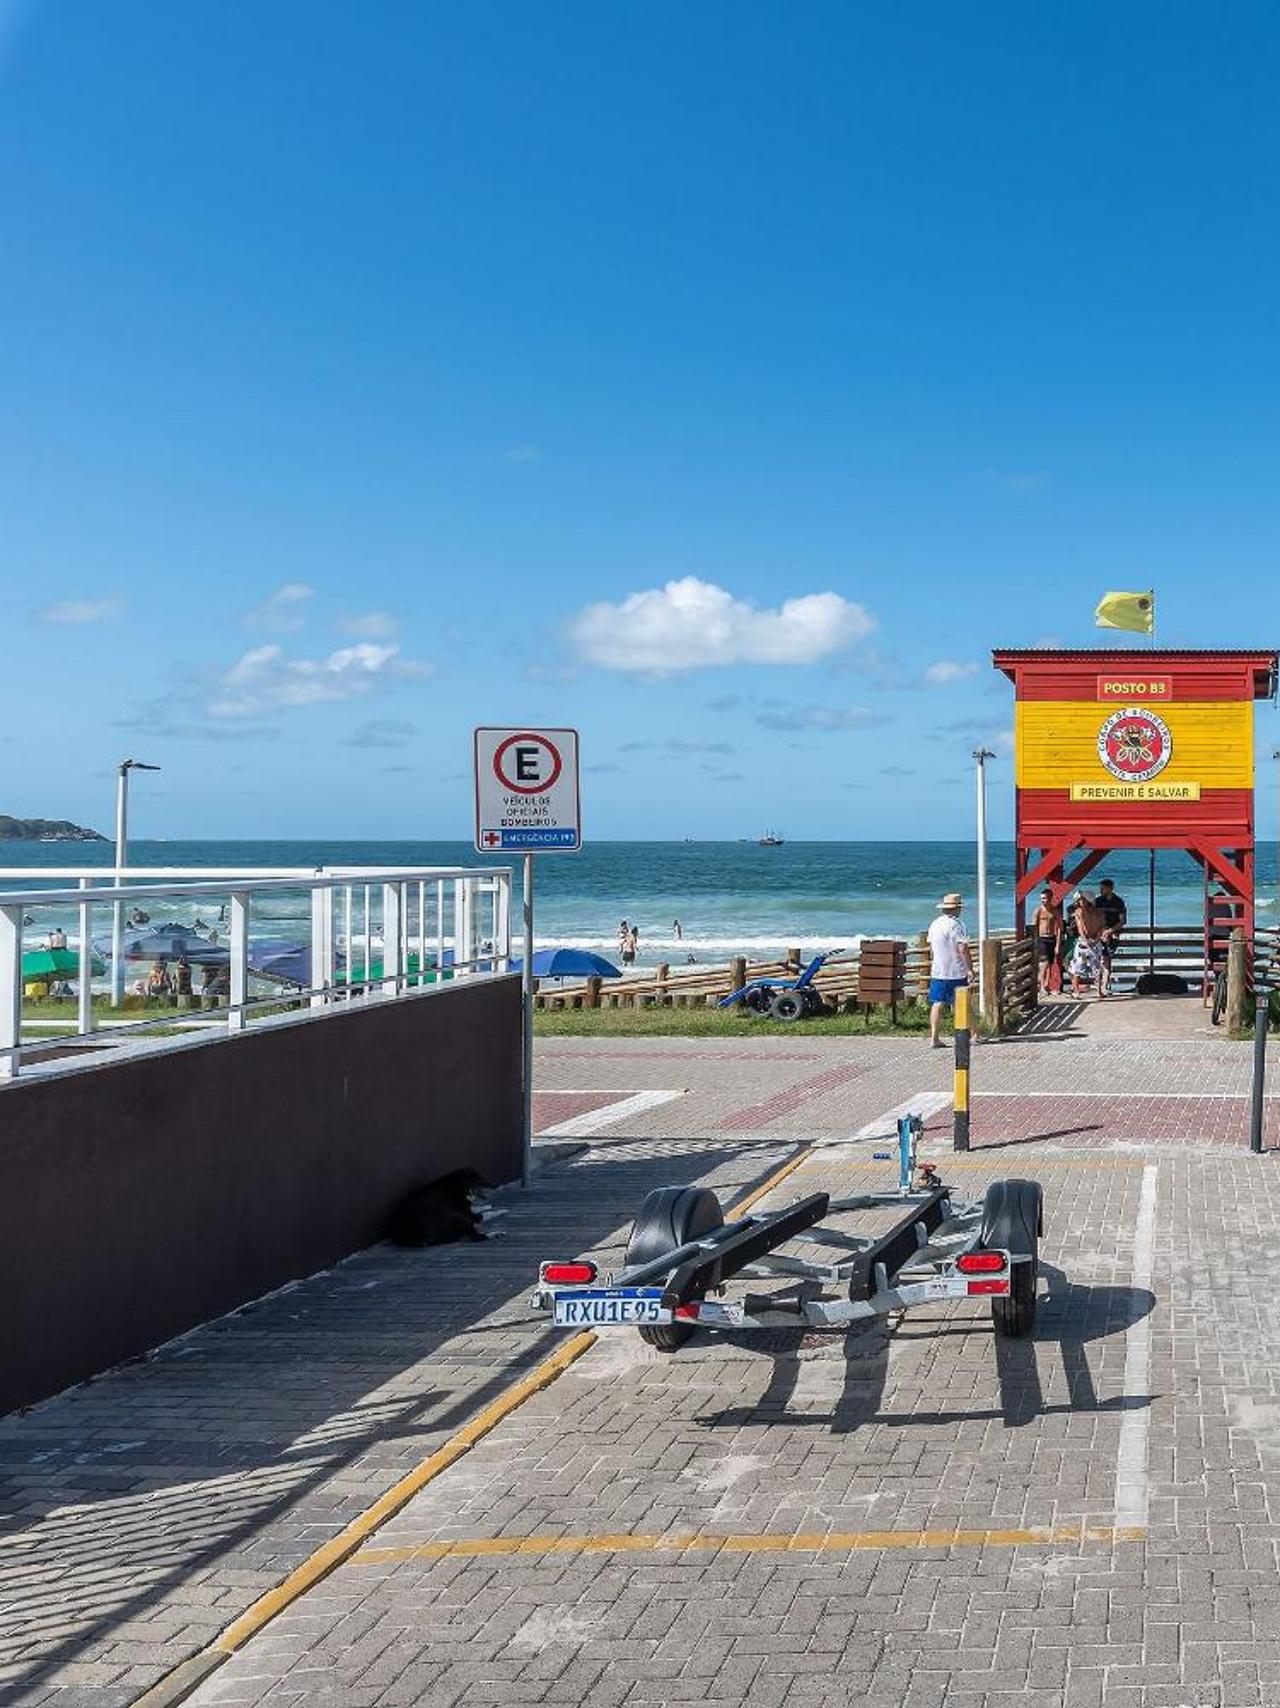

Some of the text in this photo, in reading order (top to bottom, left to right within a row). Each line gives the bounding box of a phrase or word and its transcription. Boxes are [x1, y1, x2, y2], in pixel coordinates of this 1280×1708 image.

[1104, 682, 1165, 693] POSTO B3
[516, 747, 540, 781] E
[1081, 787, 1135, 798] PREVENIR
[1148, 787, 1189, 798] SALVAR
[506, 807, 549, 817] OFICIAIS
[501, 818, 558, 827] BOMBEIROS
[565, 1300, 660, 1323] RXU1E95
